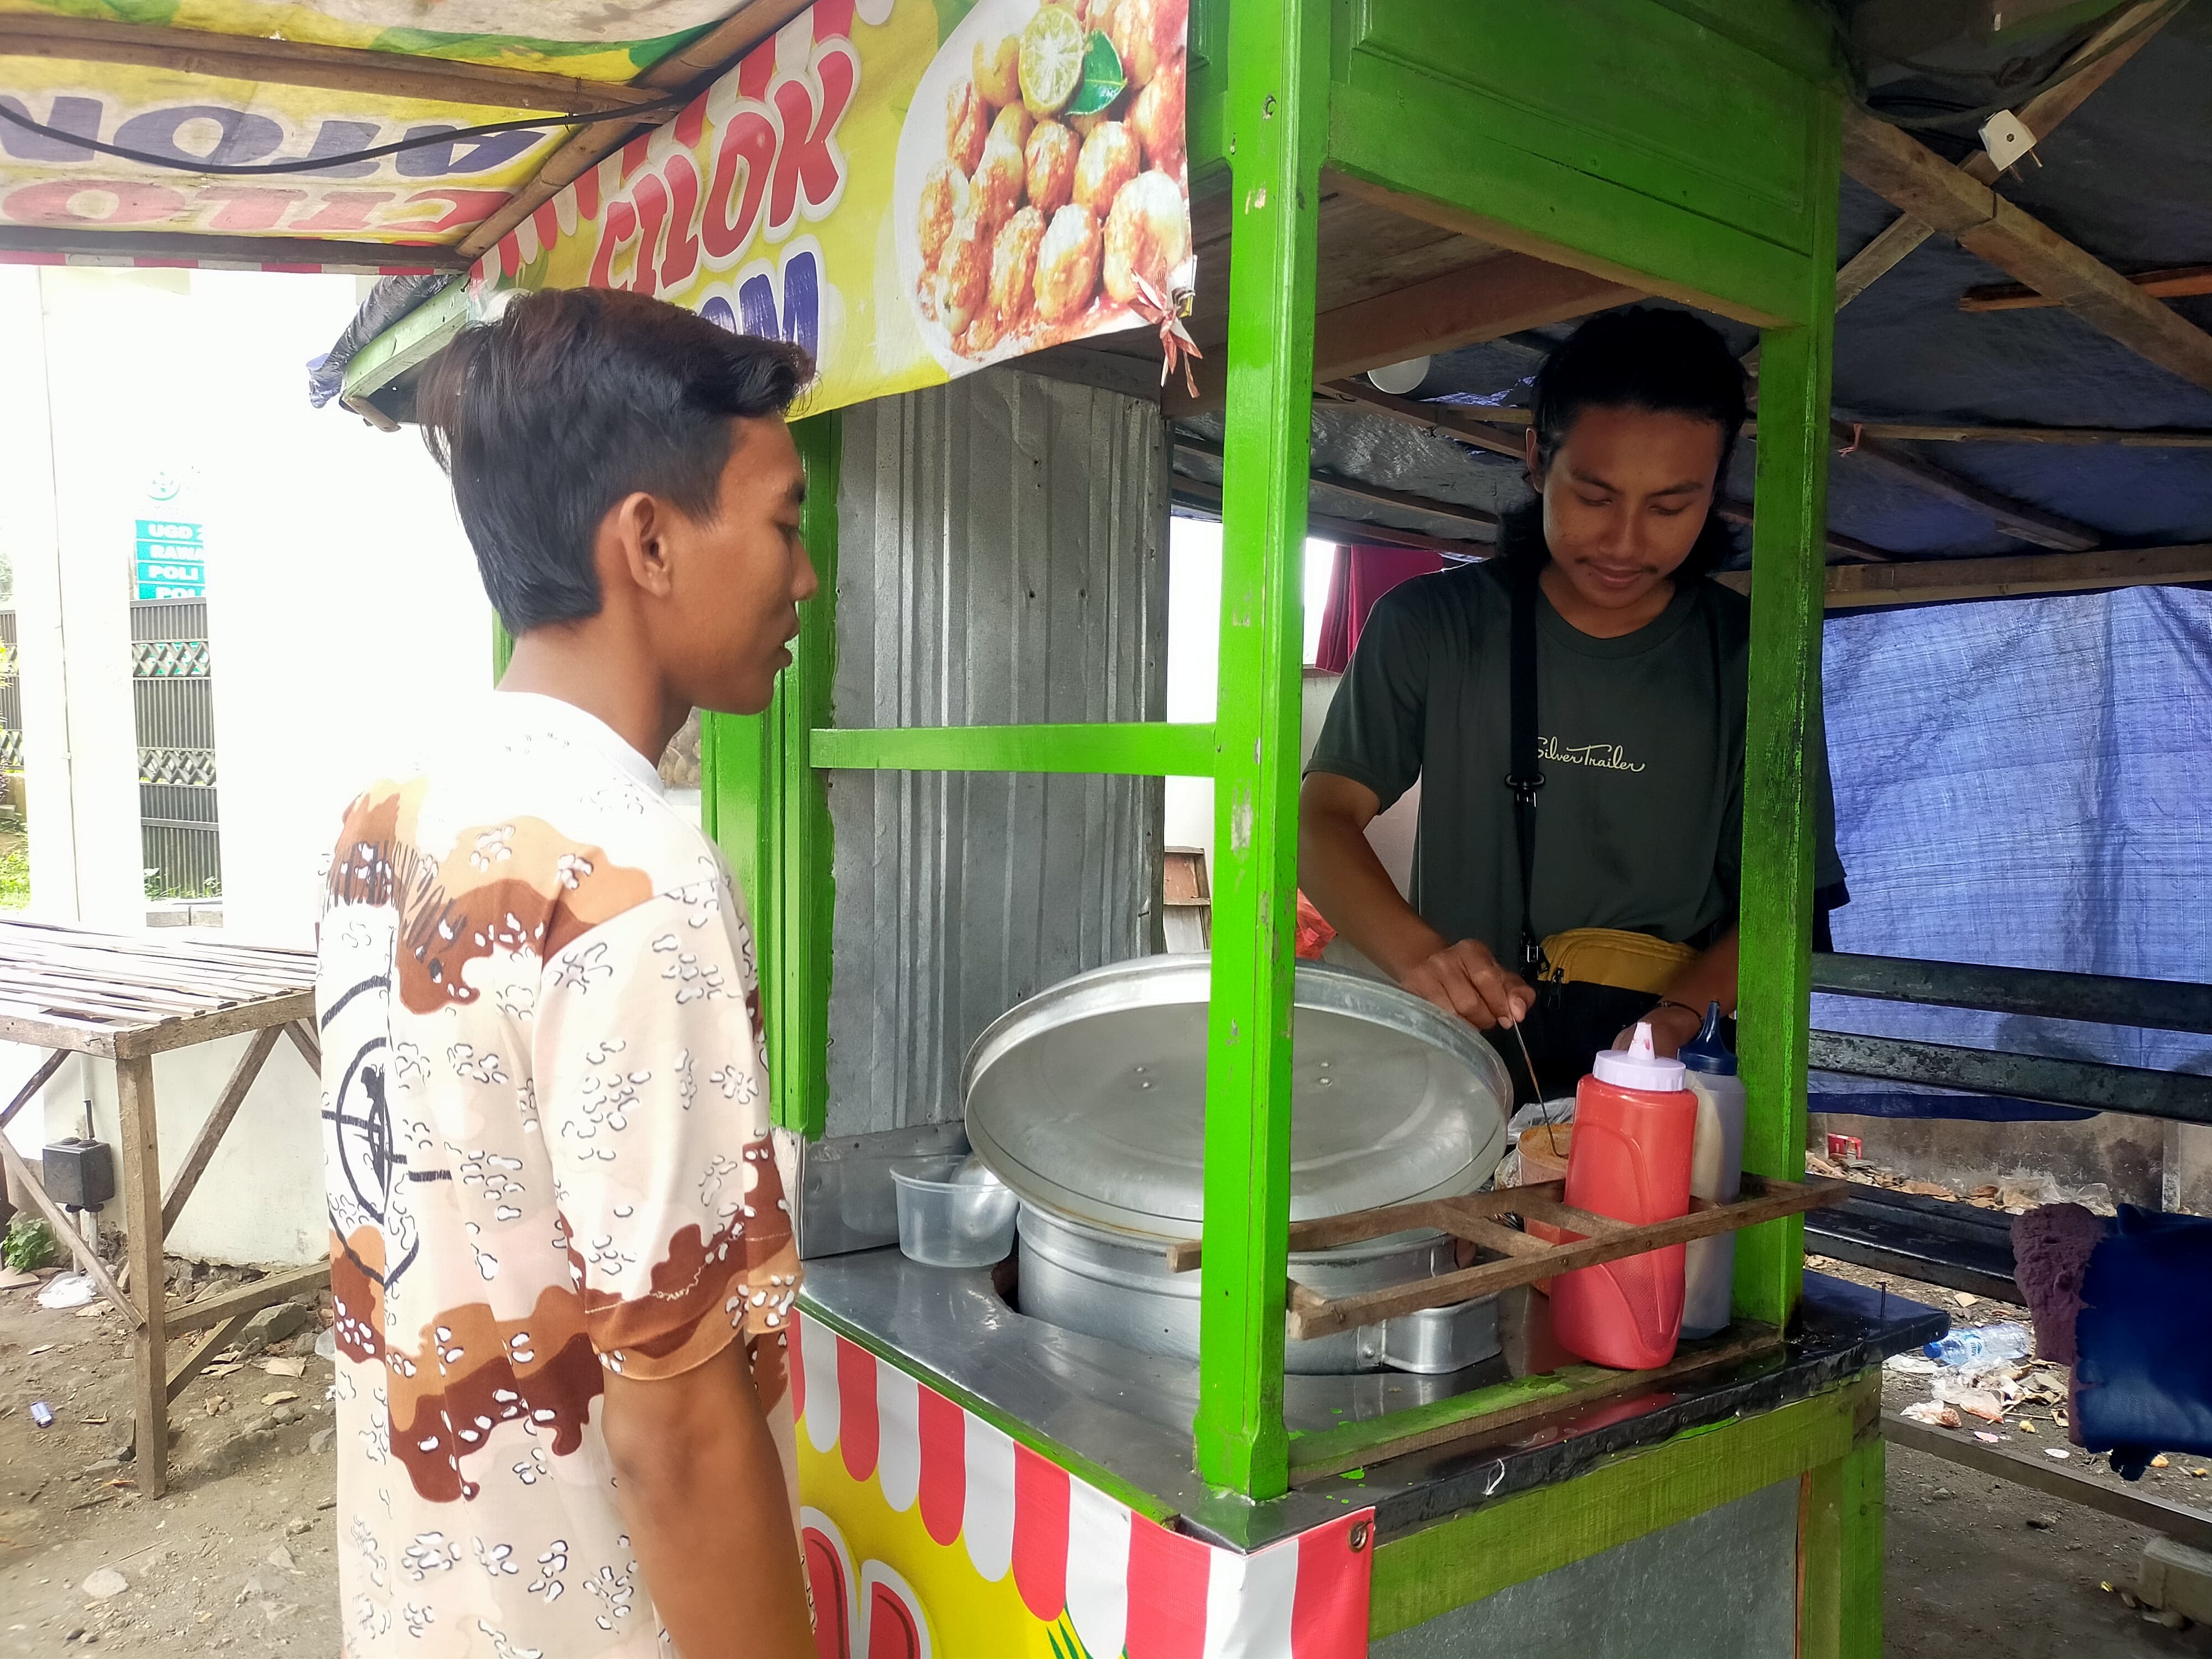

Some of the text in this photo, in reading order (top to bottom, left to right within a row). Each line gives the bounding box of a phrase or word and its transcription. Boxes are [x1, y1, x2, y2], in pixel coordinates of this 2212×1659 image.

[589, 50, 853, 293] CILOK
[149, 565, 199, 581] POLI
[1566, 744, 1646, 772] Trailer
